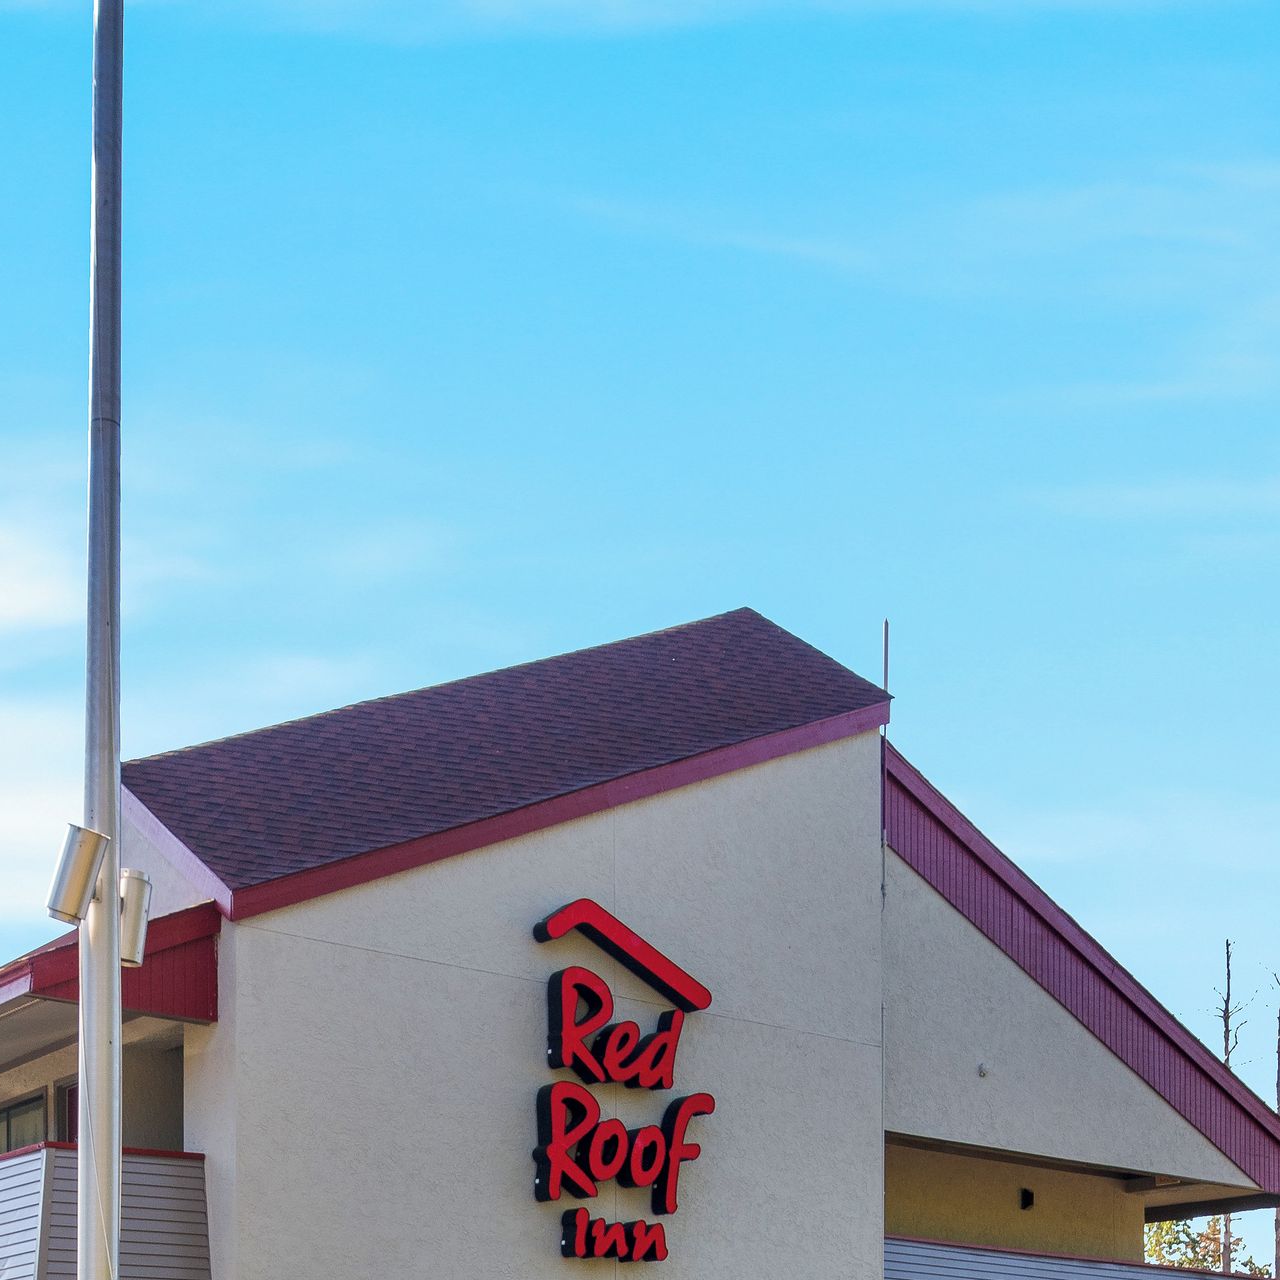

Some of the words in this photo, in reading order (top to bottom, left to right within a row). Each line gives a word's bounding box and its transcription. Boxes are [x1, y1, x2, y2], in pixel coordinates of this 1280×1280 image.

[548, 966, 684, 1089] Red
[534, 1081, 715, 1214] Roof
[562, 1207, 668, 1261] Inn
